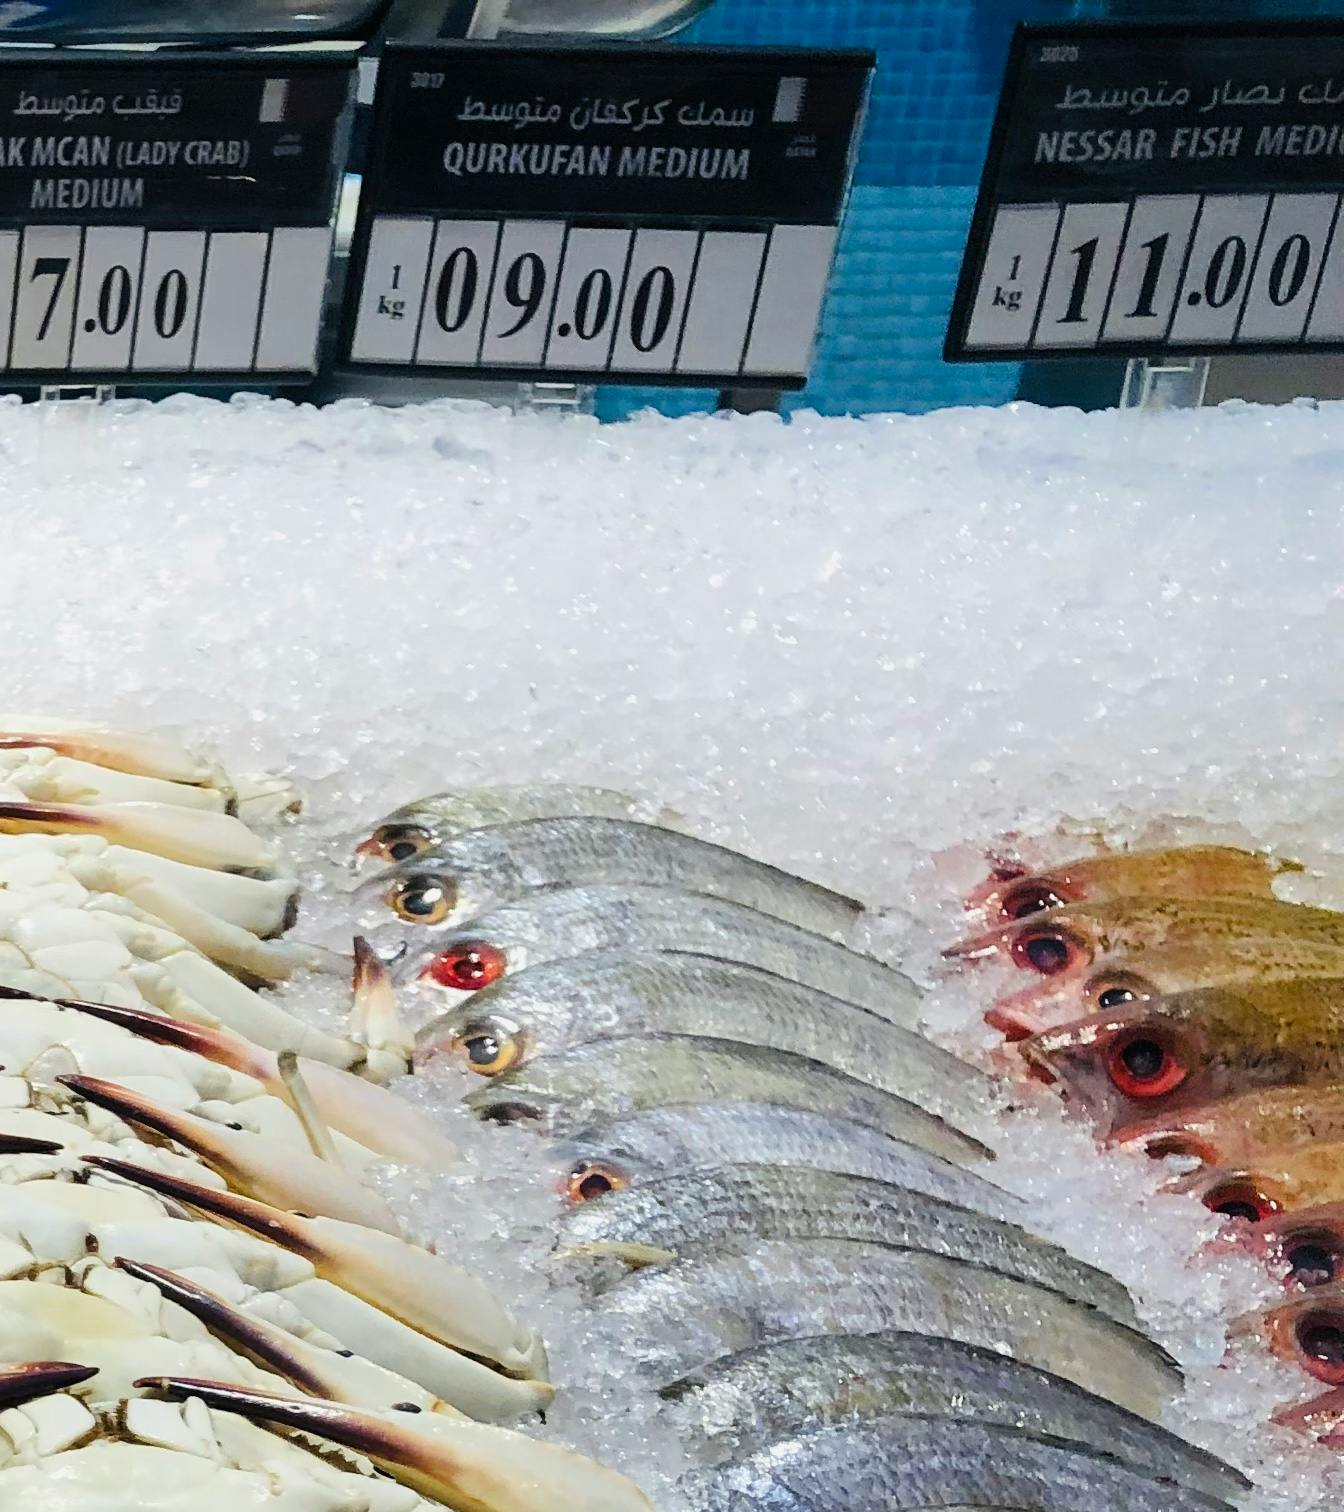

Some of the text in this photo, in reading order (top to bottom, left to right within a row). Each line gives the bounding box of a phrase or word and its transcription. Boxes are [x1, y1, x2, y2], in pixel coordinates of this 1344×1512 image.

[12, 89, 106, 122] متوسط
[455, 95, 562, 130] متوسط
[677, 98, 755, 128] سمك
[1054, 79, 1192, 116] متوسط
[1198, 78, 1287, 113] نصار
[30, 135, 111, 168] MCAN
[116, 139, 180, 169] (LADY
[183, 138, 250, 168] CRAB)
[442, 141, 612, 178] QURKUFAN
[616, 146, 751, 180] MEDIUM
[1033, 127, 1158, 164] NESSAR
[1170, 125, 1244, 159] FISH
[30, 177, 144, 209] MEDIUM
[1055, 232, 1312, 324] 11.00
[376, 294, 406, 320] kg
[434, 246, 676, 353] 09.00
[991, 286, 1023, 312] kg
